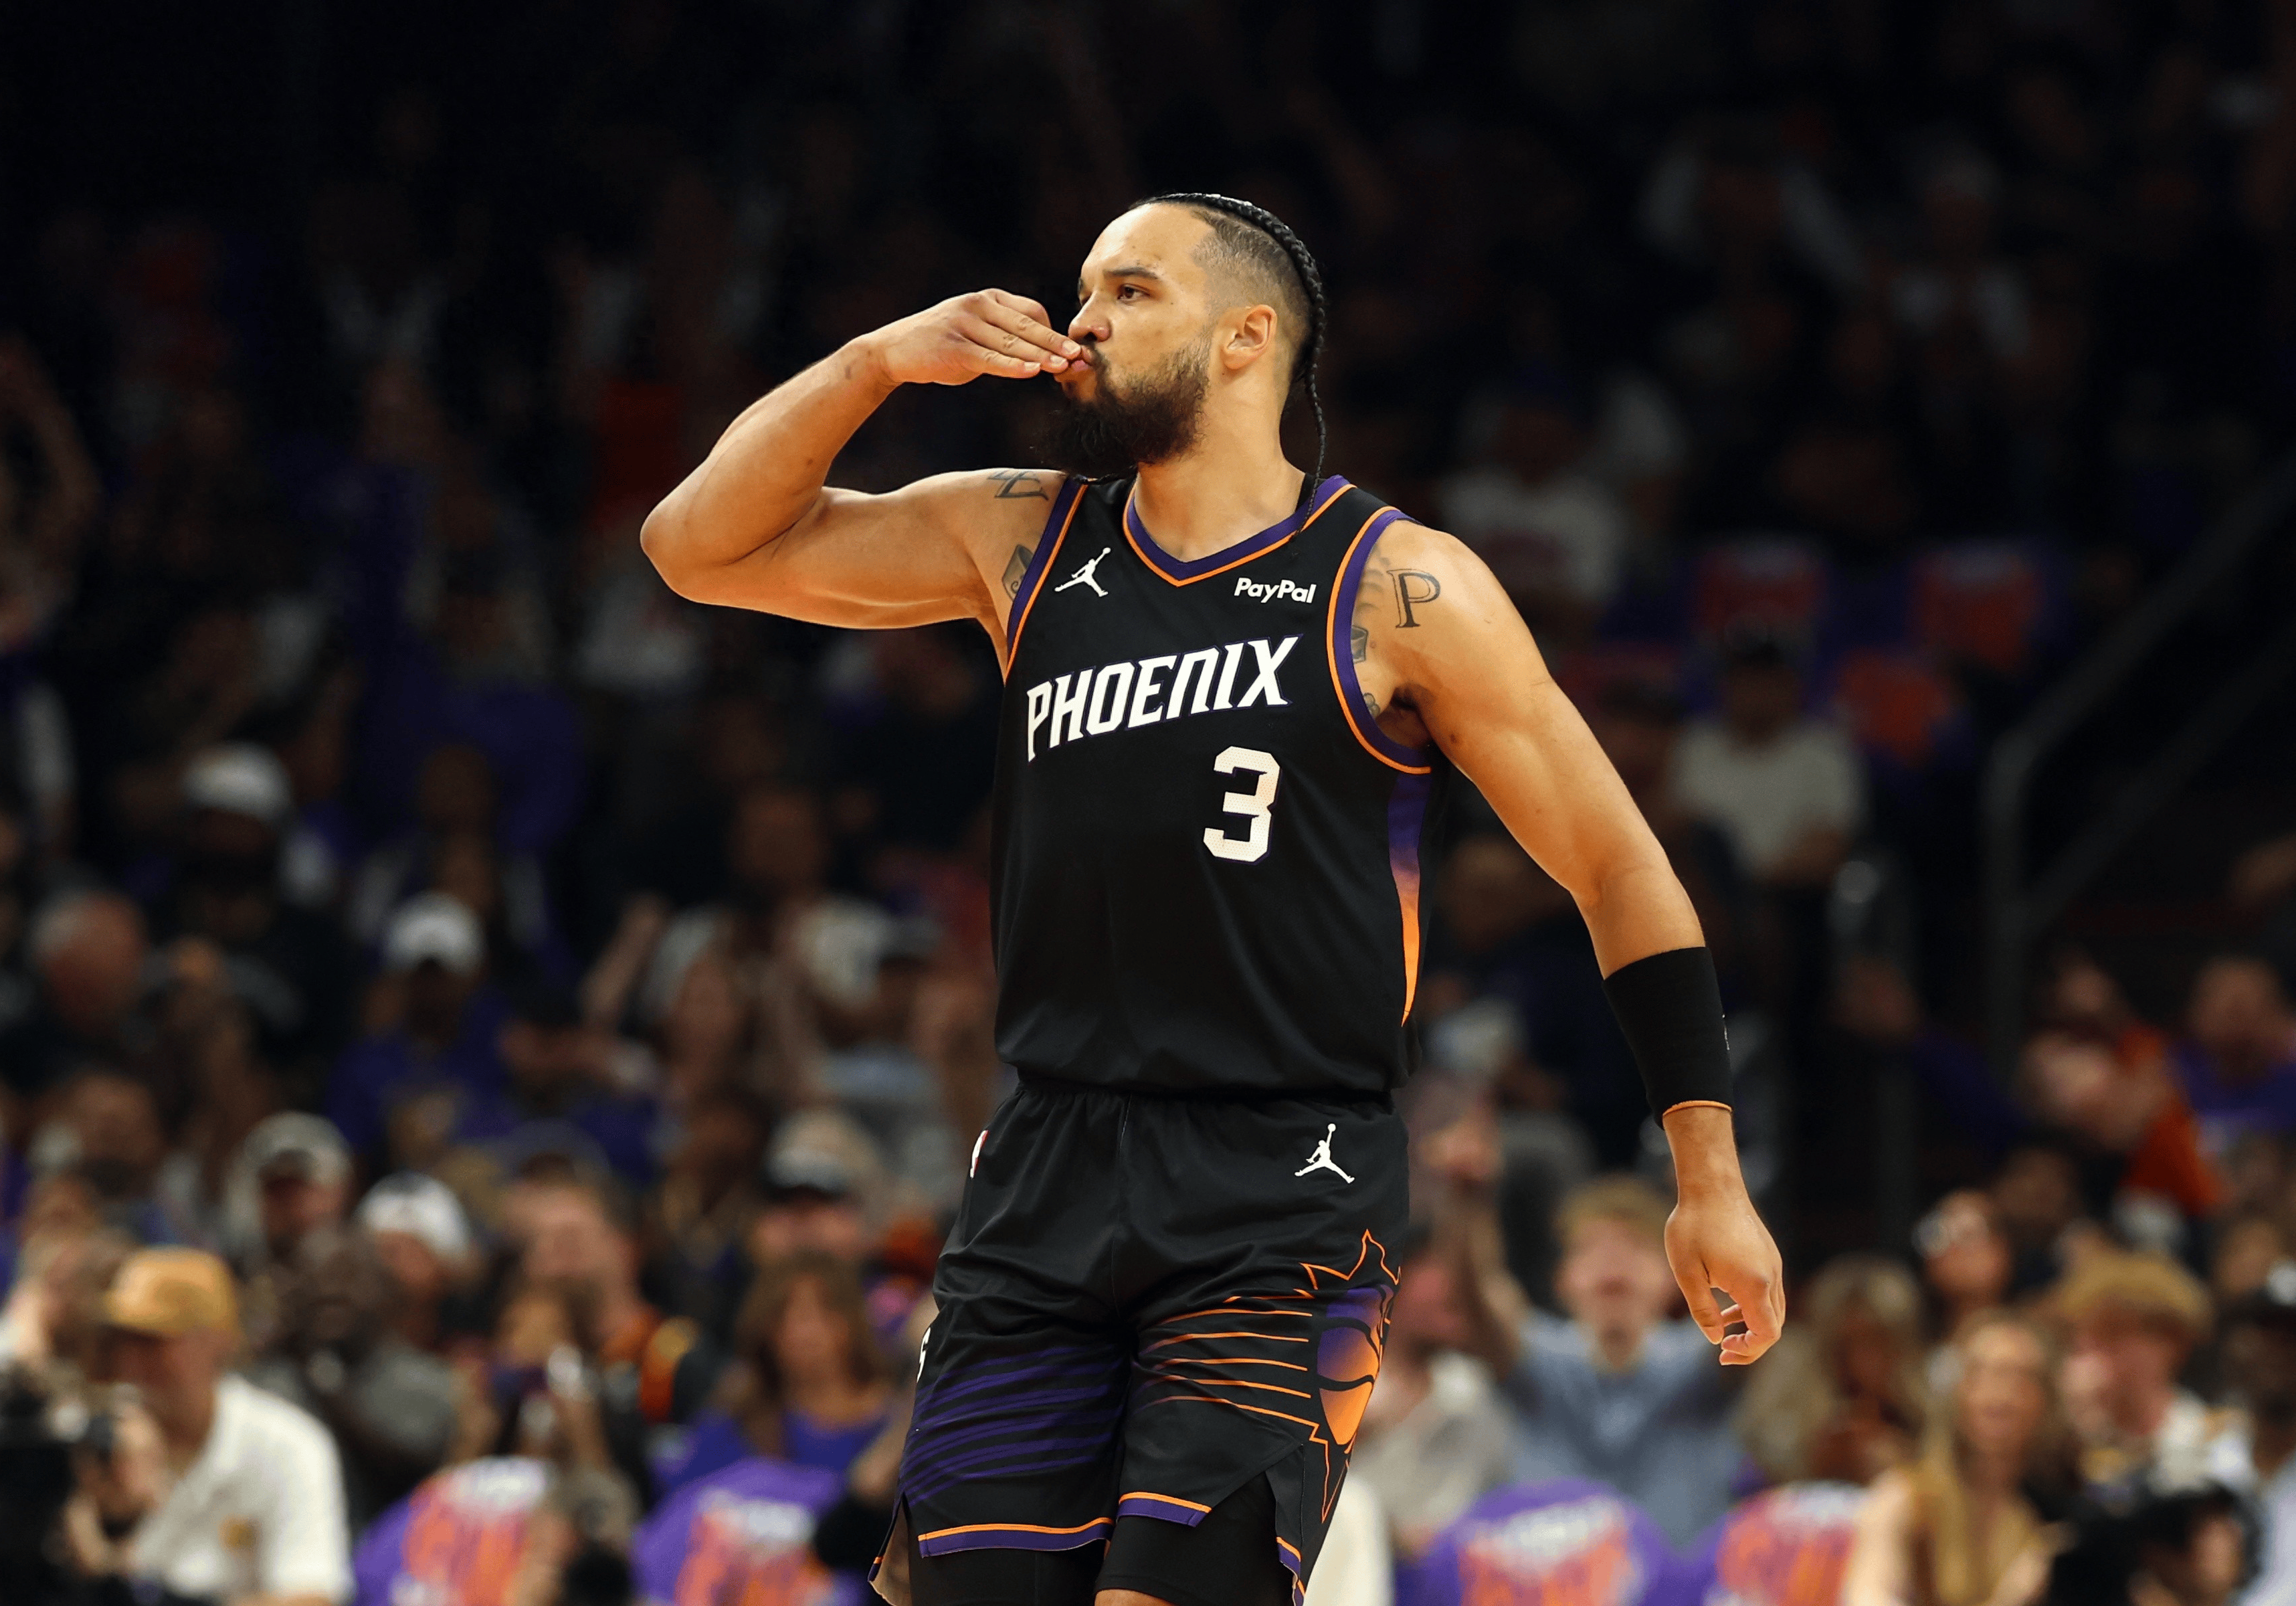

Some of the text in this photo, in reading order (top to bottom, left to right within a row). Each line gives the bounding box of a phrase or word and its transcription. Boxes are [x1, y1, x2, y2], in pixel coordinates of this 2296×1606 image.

[1234, 577, 1317, 604] PayPal
[1386, 568, 1441, 629] P
[1026, 634, 1302, 762] PHOENIX
[1203, 745, 1281, 863] 3
